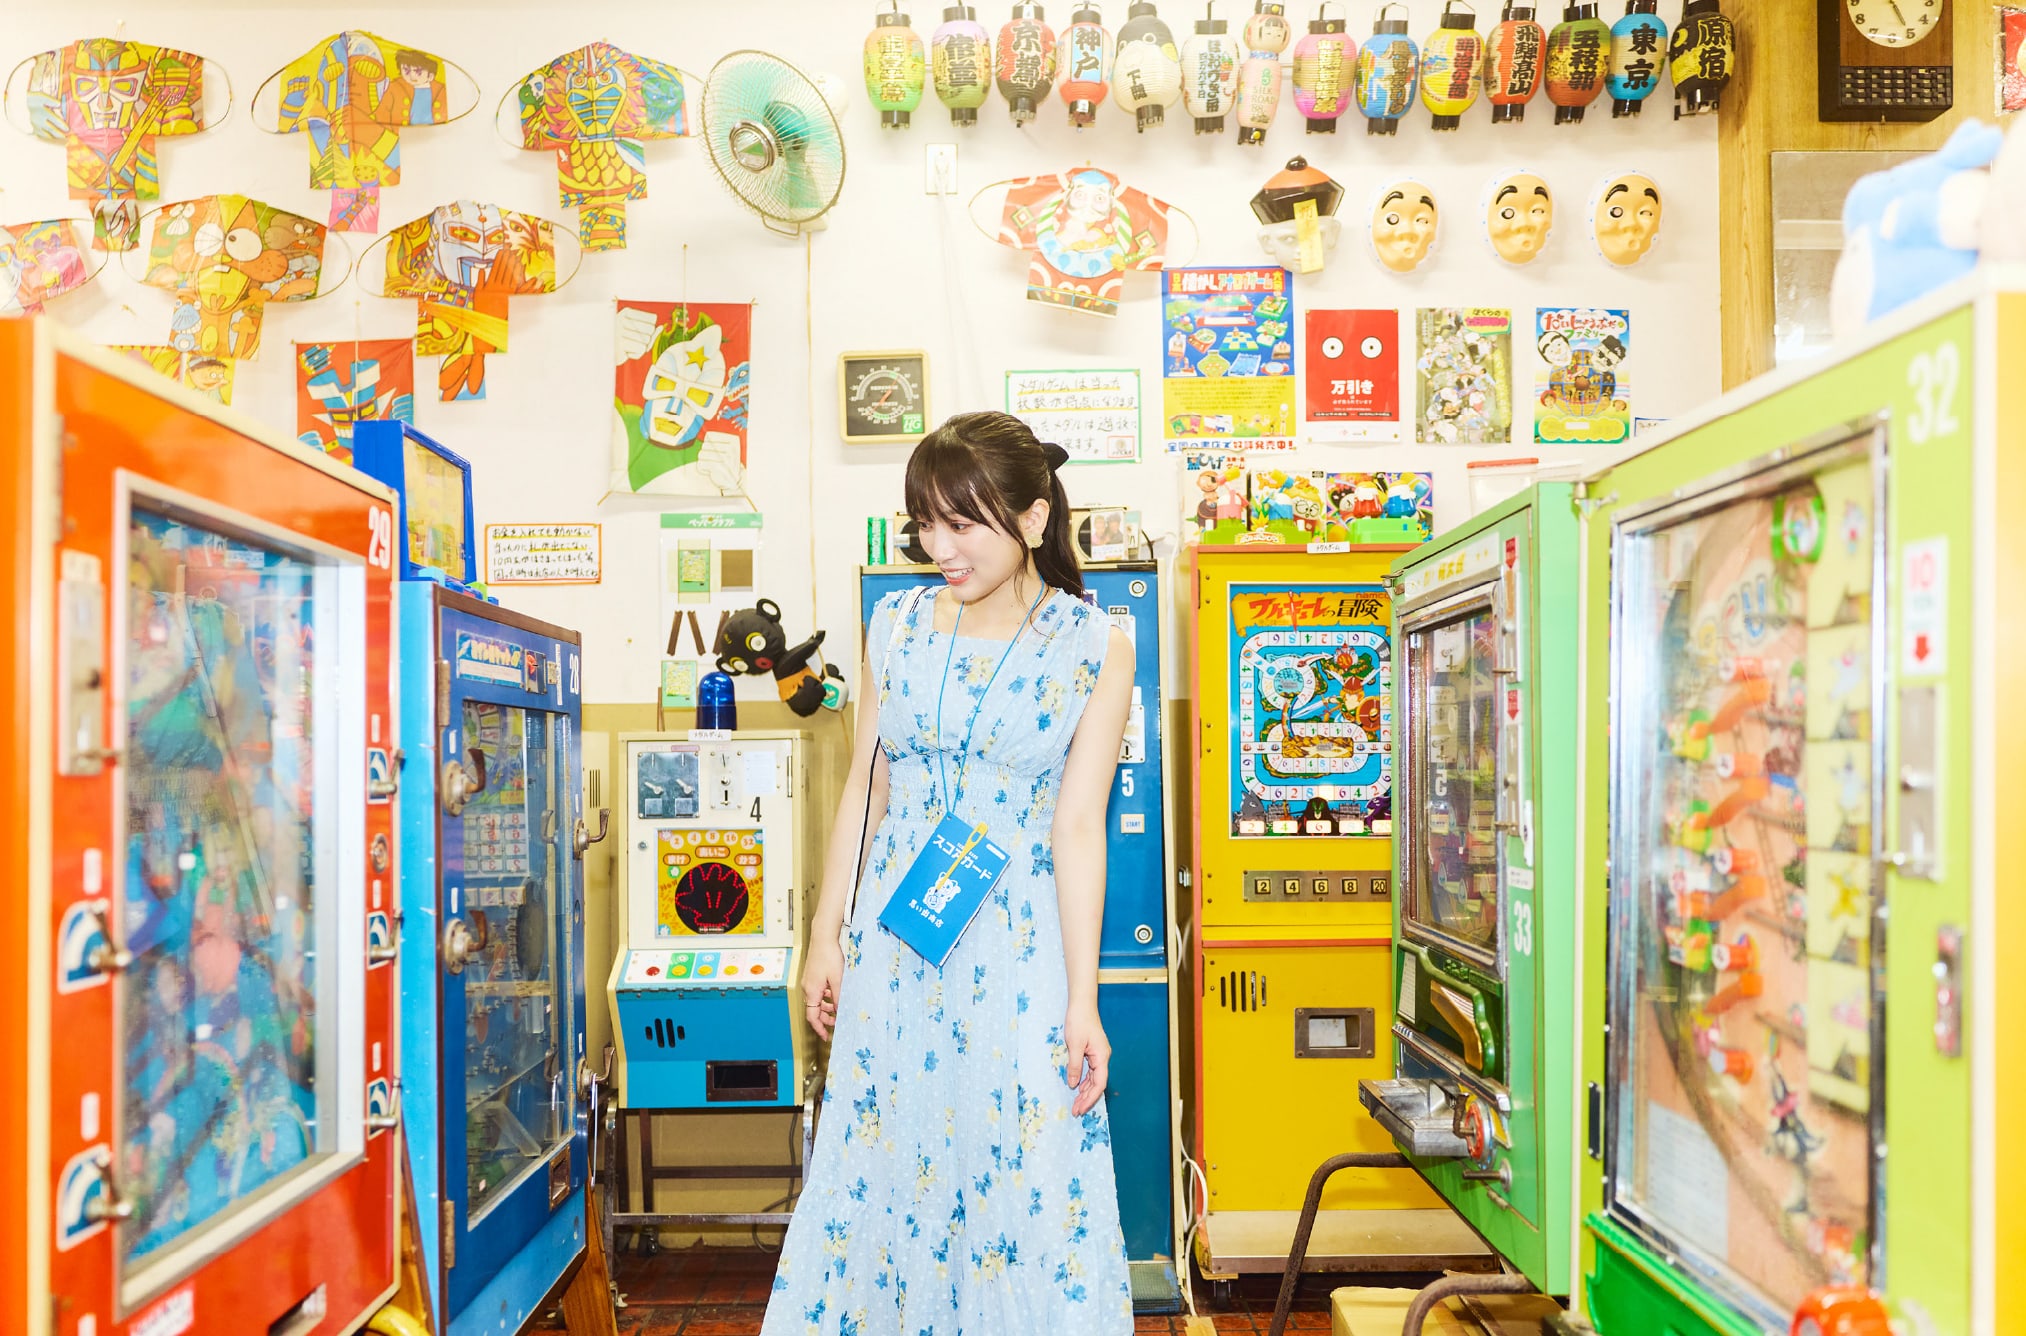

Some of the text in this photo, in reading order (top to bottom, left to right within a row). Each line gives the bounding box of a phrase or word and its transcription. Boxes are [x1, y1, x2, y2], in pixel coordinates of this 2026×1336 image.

[1855, 14, 1866, 25] 8
[1918, 14, 1929, 25] 4
[1887, 33, 1897, 44] 6
[1906, 28, 1916, 40] 5
[1012, 18, 1043, 87] 京都
[1074, 26, 1102, 79] 神戸
[1698, 19, 1726, 79] 原宿
[1568, 30, 1600, 90] 五稜郭
[1624, 23, 1658, 90] 東京
[1564, 329, 1606, 339] ファミリー
[1330, 379, 1374, 395] 万引き
[1907, 342, 1960, 444] 32
[904, 419, 921, 430] HG
[368, 506, 391, 570] 29
[1248, 597, 1384, 621] ワルキューレの冒険
[570, 653, 580, 695] 28
[1121, 768, 1135, 797] 5
[750, 796, 762, 823] 4
[1125, 820, 1142, 829] START
[667, 855, 686, 864] まけ
[699, 848, 726, 857] あいこ
[739, 855, 758, 864] かち
[932, 834, 993, 880] スコアカード
[1260, 881, 1267, 892] 2
[1289, 881, 1297, 892] 4
[1317, 881, 1325, 892] 6
[1346, 881, 1354, 892] 8
[1374, 881, 1386, 893] 20
[908, 898, 944, 929] 思い出商店
[1513, 900, 1533, 956] 33
